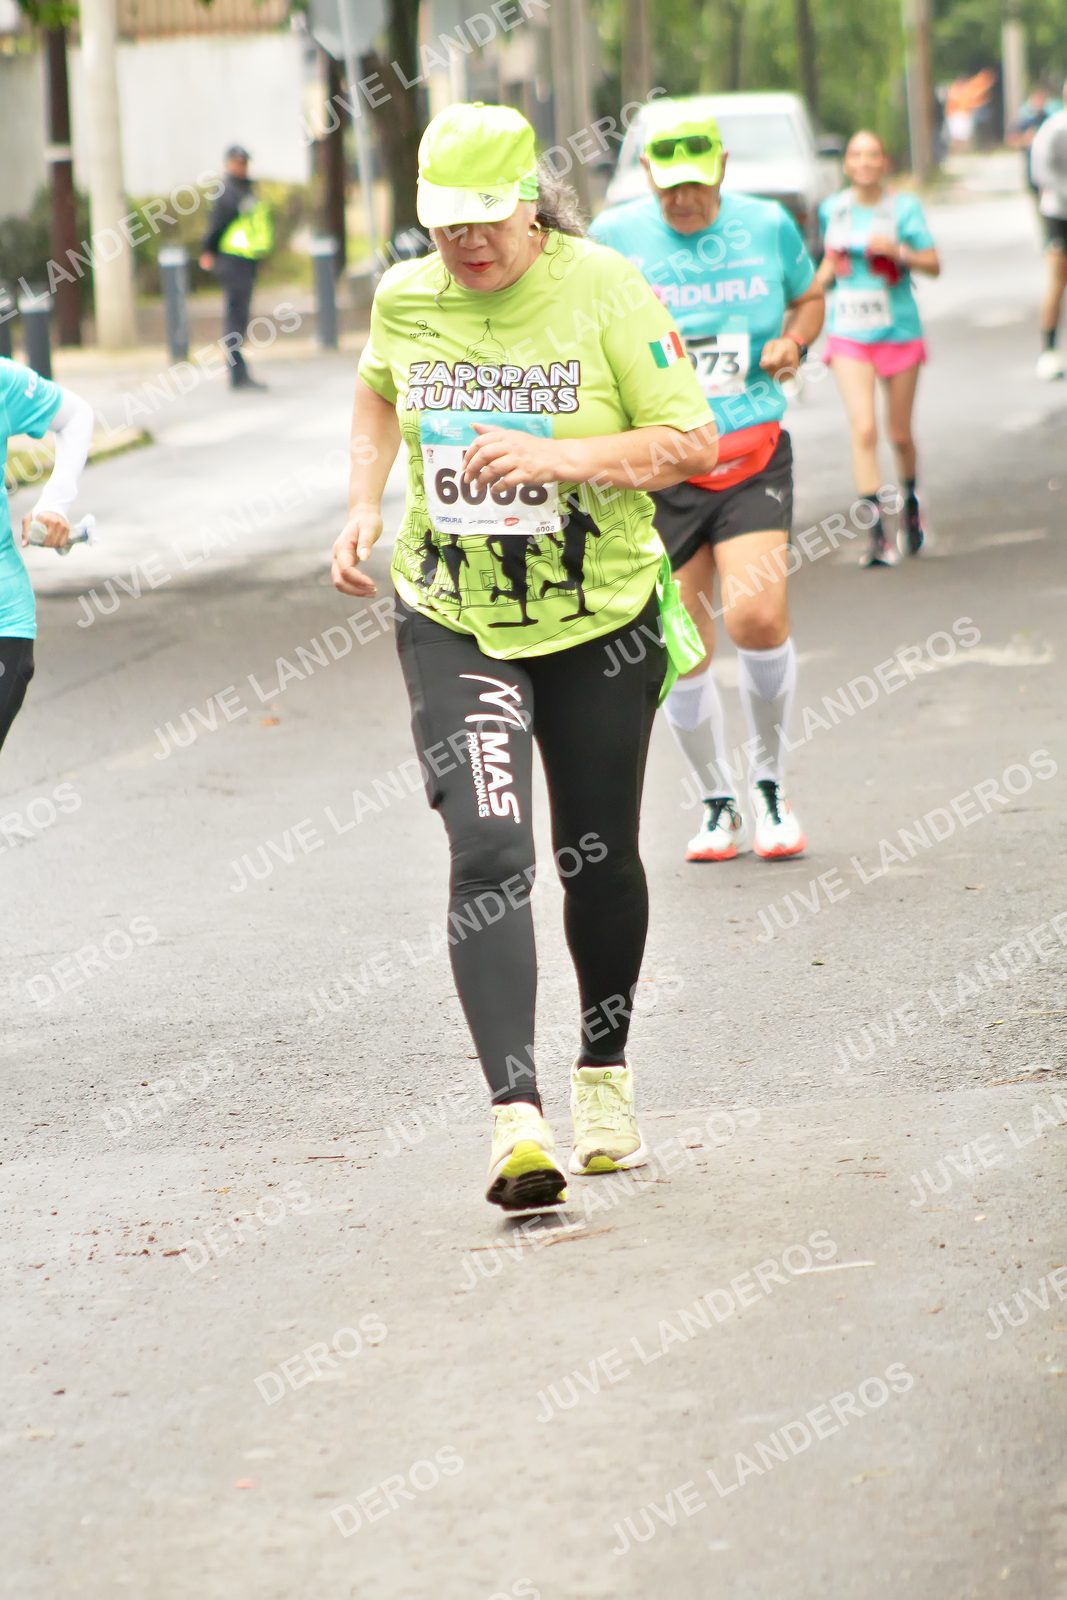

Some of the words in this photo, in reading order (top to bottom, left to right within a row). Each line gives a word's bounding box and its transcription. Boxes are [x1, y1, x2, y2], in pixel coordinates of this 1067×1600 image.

[406, 386, 580, 414] RUNNERS
[408, 361, 580, 390] ZAPOPAN
[466, 732, 490, 818] PROMOCIONALES
[480, 732, 521, 822] MAS
